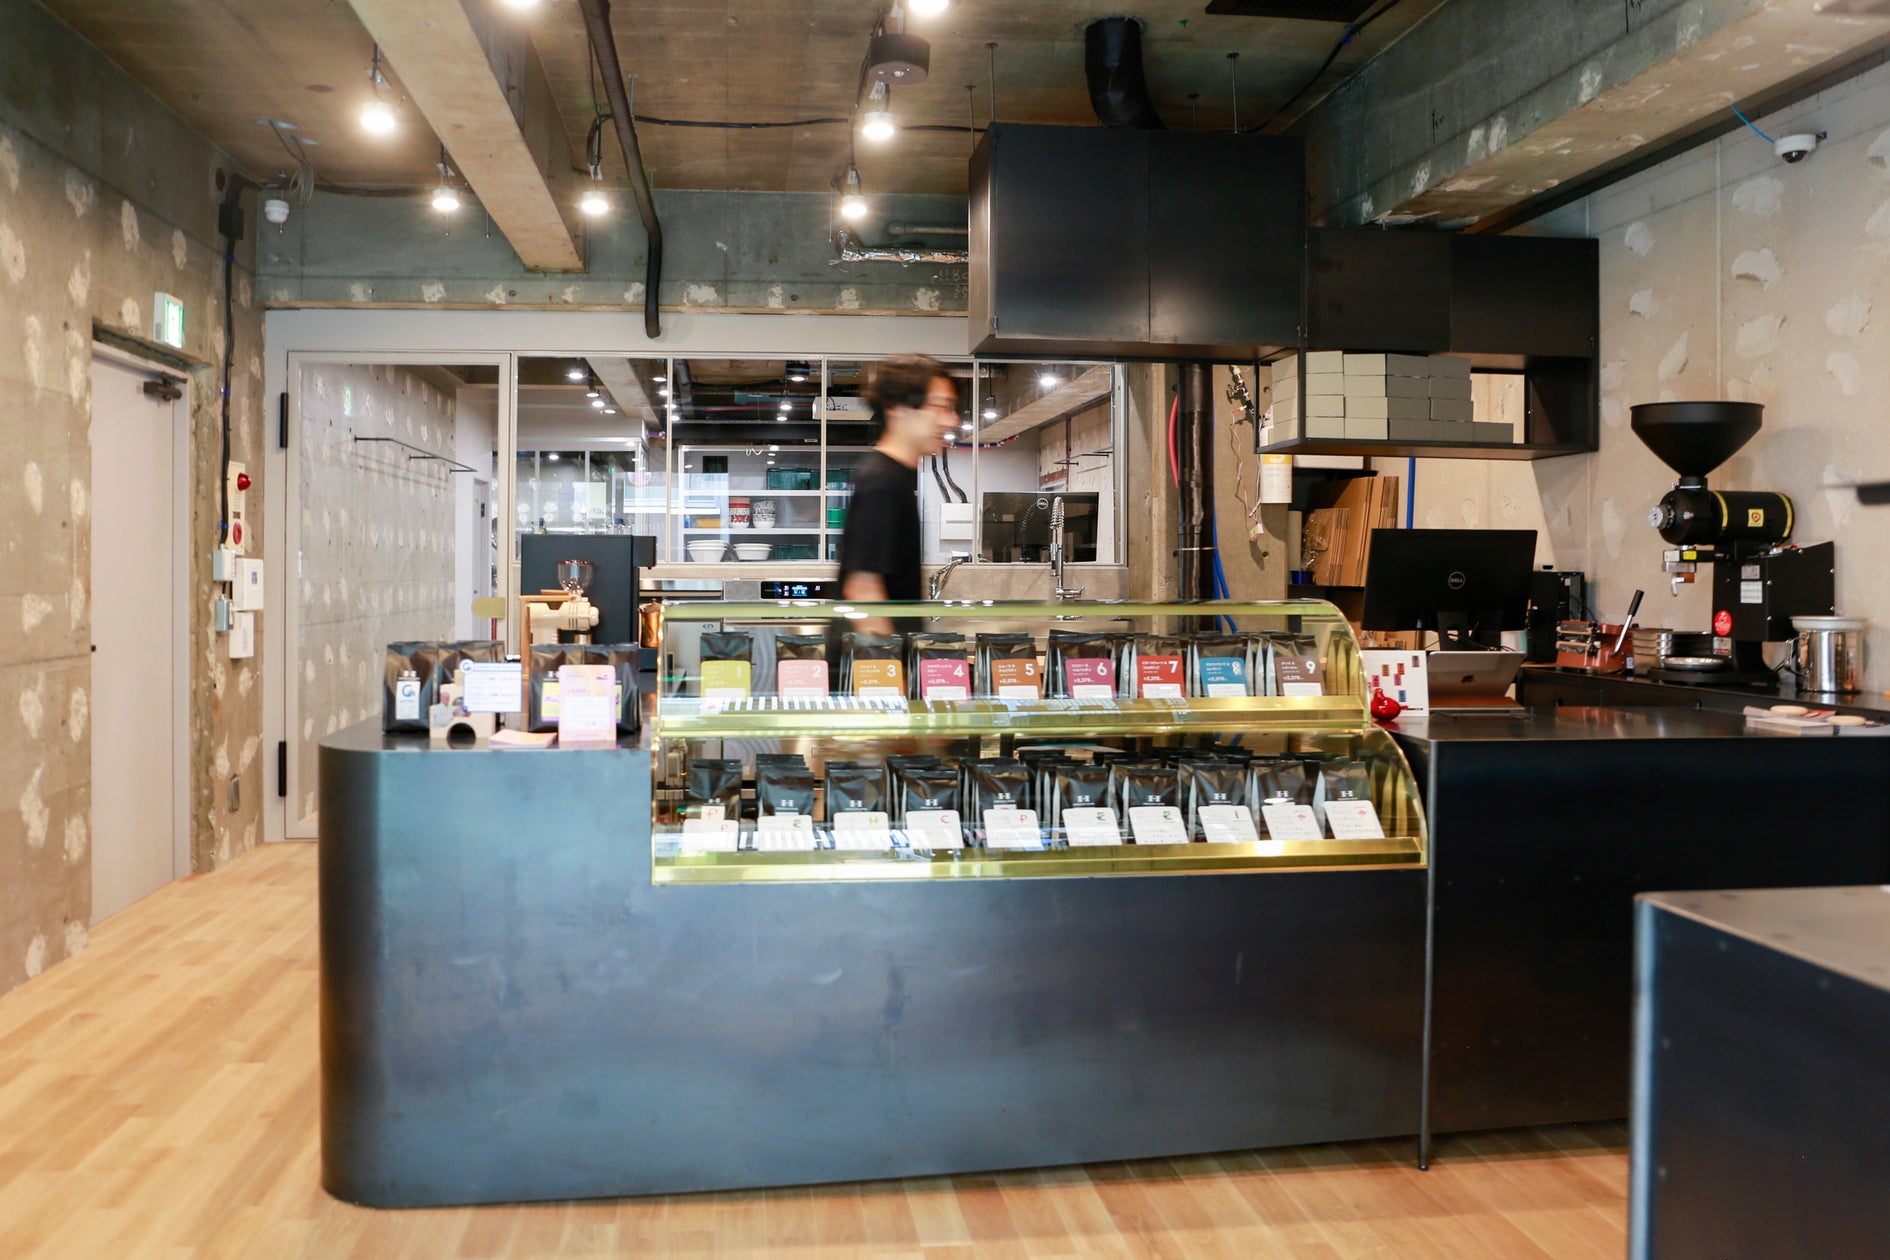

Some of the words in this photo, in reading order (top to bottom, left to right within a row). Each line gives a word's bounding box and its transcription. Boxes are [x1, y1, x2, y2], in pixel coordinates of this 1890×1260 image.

[812, 664, 823, 678] 2
[886, 664, 897, 678] 3
[953, 663, 965, 677] 4
[1025, 663, 1035, 676] 5
[1097, 662, 1108, 676] 6
[1168, 660, 1179, 674] 7
[1305, 660, 1316, 674] 9
